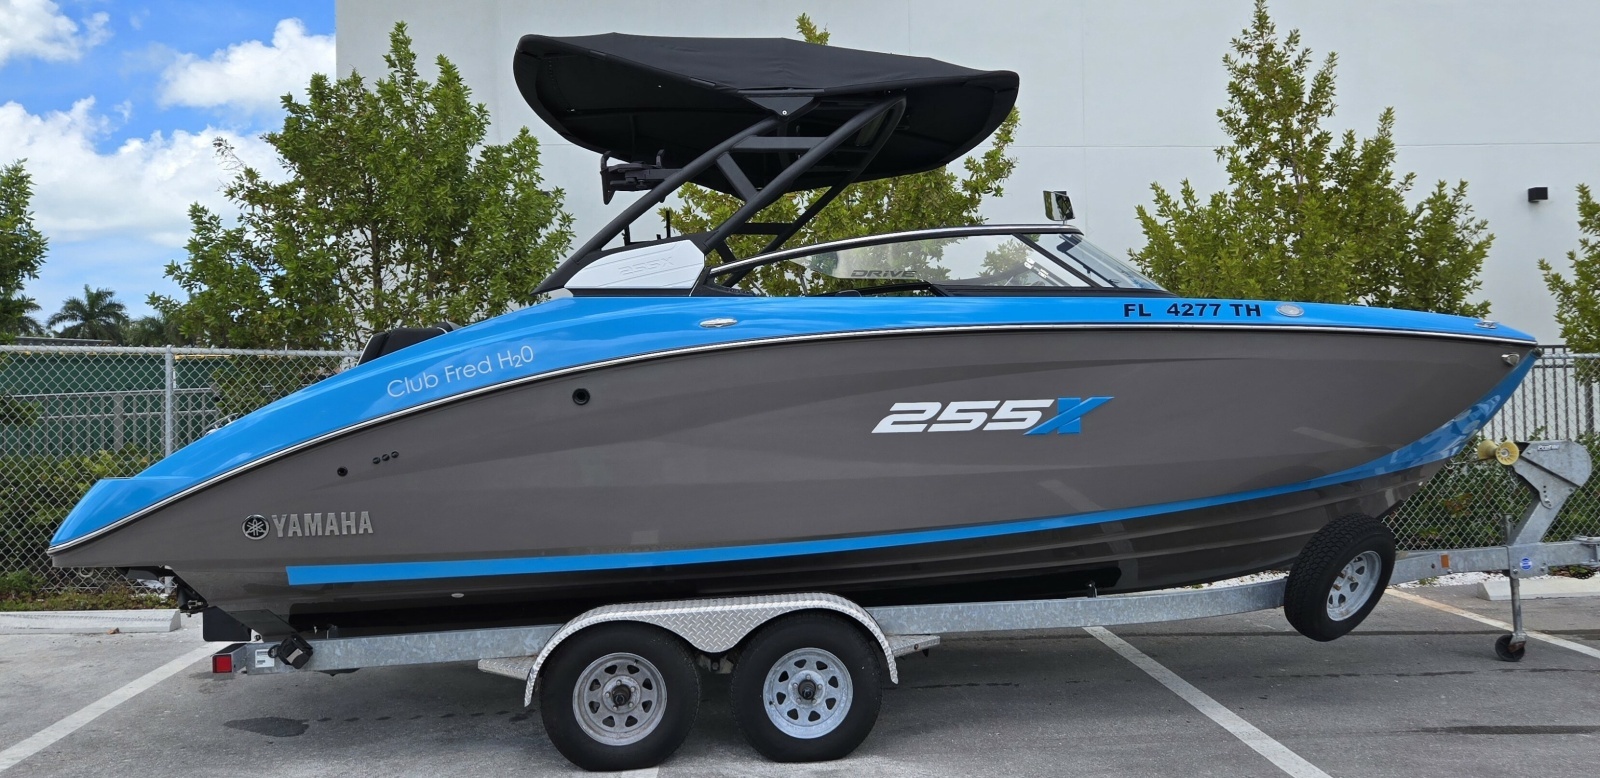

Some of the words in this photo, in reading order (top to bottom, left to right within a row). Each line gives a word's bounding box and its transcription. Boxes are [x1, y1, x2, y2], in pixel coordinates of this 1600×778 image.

[1123, 303, 1151, 317] FL
[1166, 303, 1221, 317] 4277
[1229, 303, 1261, 317] TH
[387, 372, 439, 397] Club
[444, 355, 493, 383] Fred
[871, 397, 1115, 435] 255X
[271, 511, 374, 538] YAMAHA
